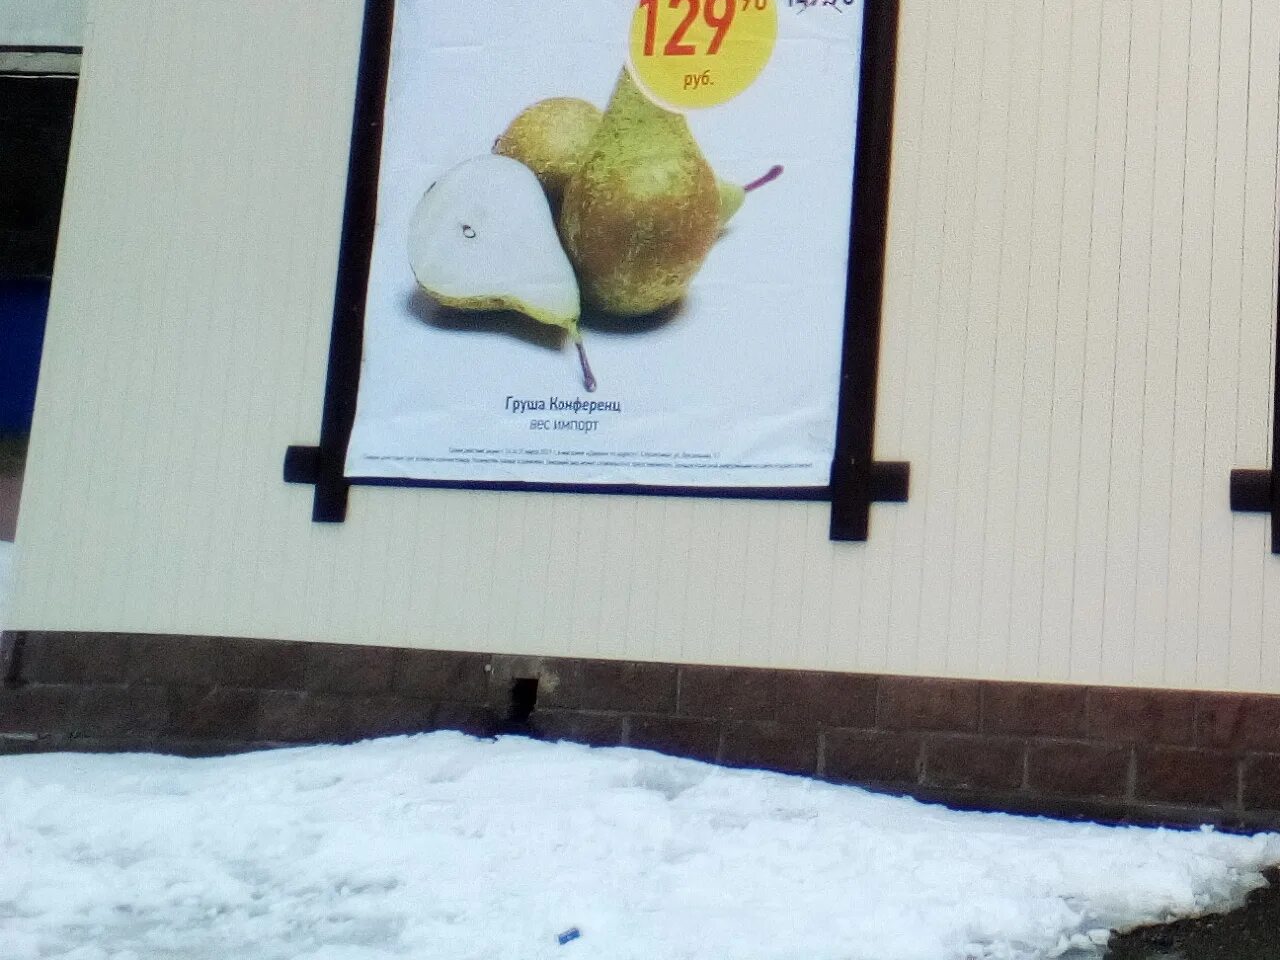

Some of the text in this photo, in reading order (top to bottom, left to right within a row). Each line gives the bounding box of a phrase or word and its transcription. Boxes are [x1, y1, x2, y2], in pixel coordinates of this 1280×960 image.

[683, 69, 715, 90] руб.
[505, 395, 622, 415] Груша Конференц
